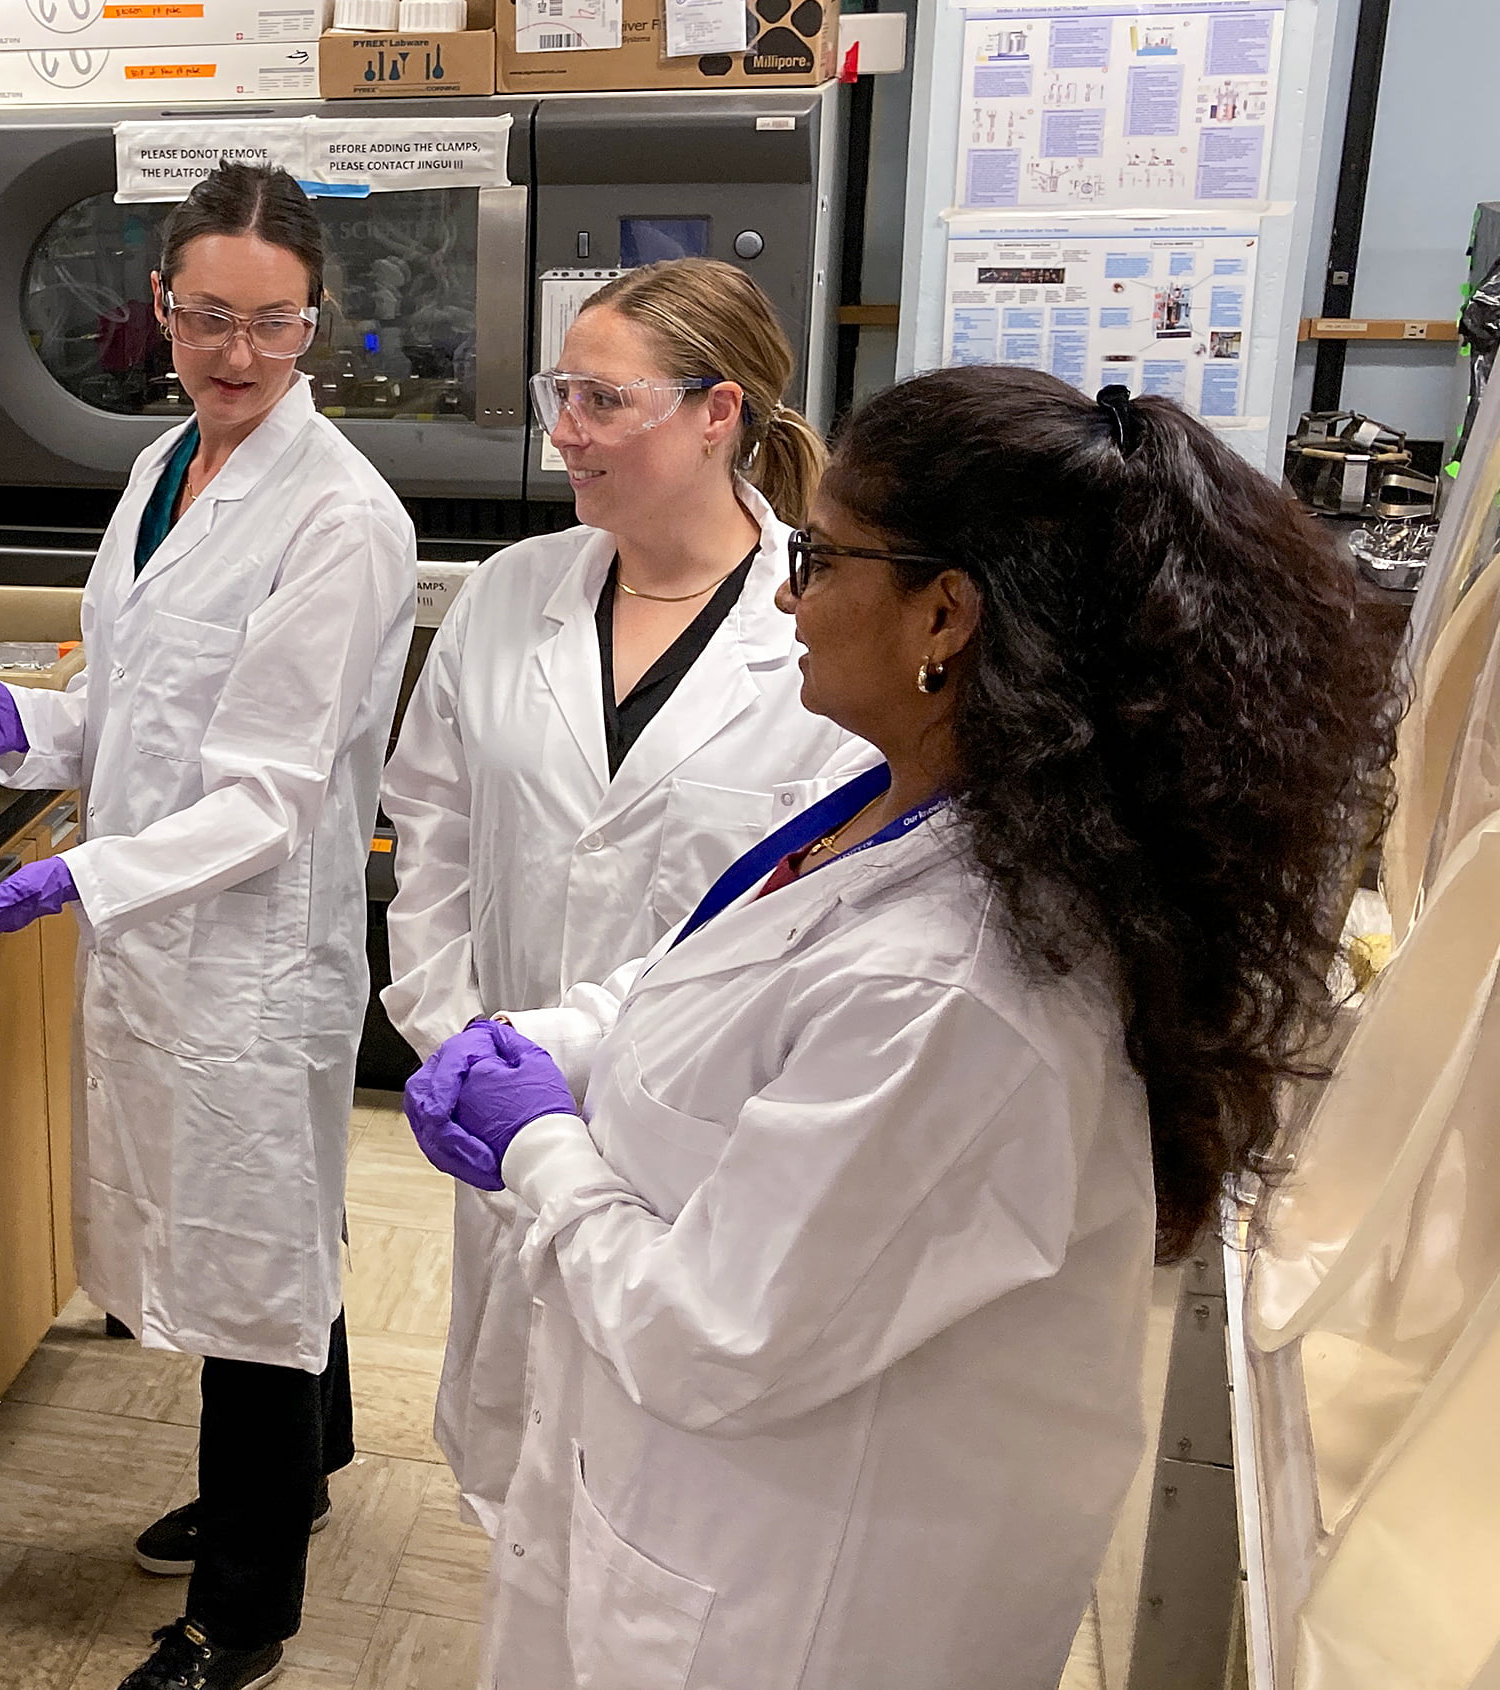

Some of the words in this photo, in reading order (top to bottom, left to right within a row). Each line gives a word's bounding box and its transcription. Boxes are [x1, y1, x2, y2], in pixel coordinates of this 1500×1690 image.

[621, 20, 648, 31] iver
[389, 39, 429, 47] Labware
[329, 144, 367, 153] BEFORE
[370, 143, 411, 152] ADDING
[414, 143, 433, 152] THE
[436, 142, 481, 152] CLAMPS,
[141, 150, 178, 159] PLEASE
[181, 149, 219, 159] DONOT
[222, 148, 268, 158] REMOVE
[330, 161, 365, 170] PLEASE
[367, 160, 415, 170] CONTACT
[141, 168, 161, 177] THE
[164, 168, 210, 177] PLATFOR
[416, 582, 447, 592] AMPS,
[903, 814, 918, 826] Our
